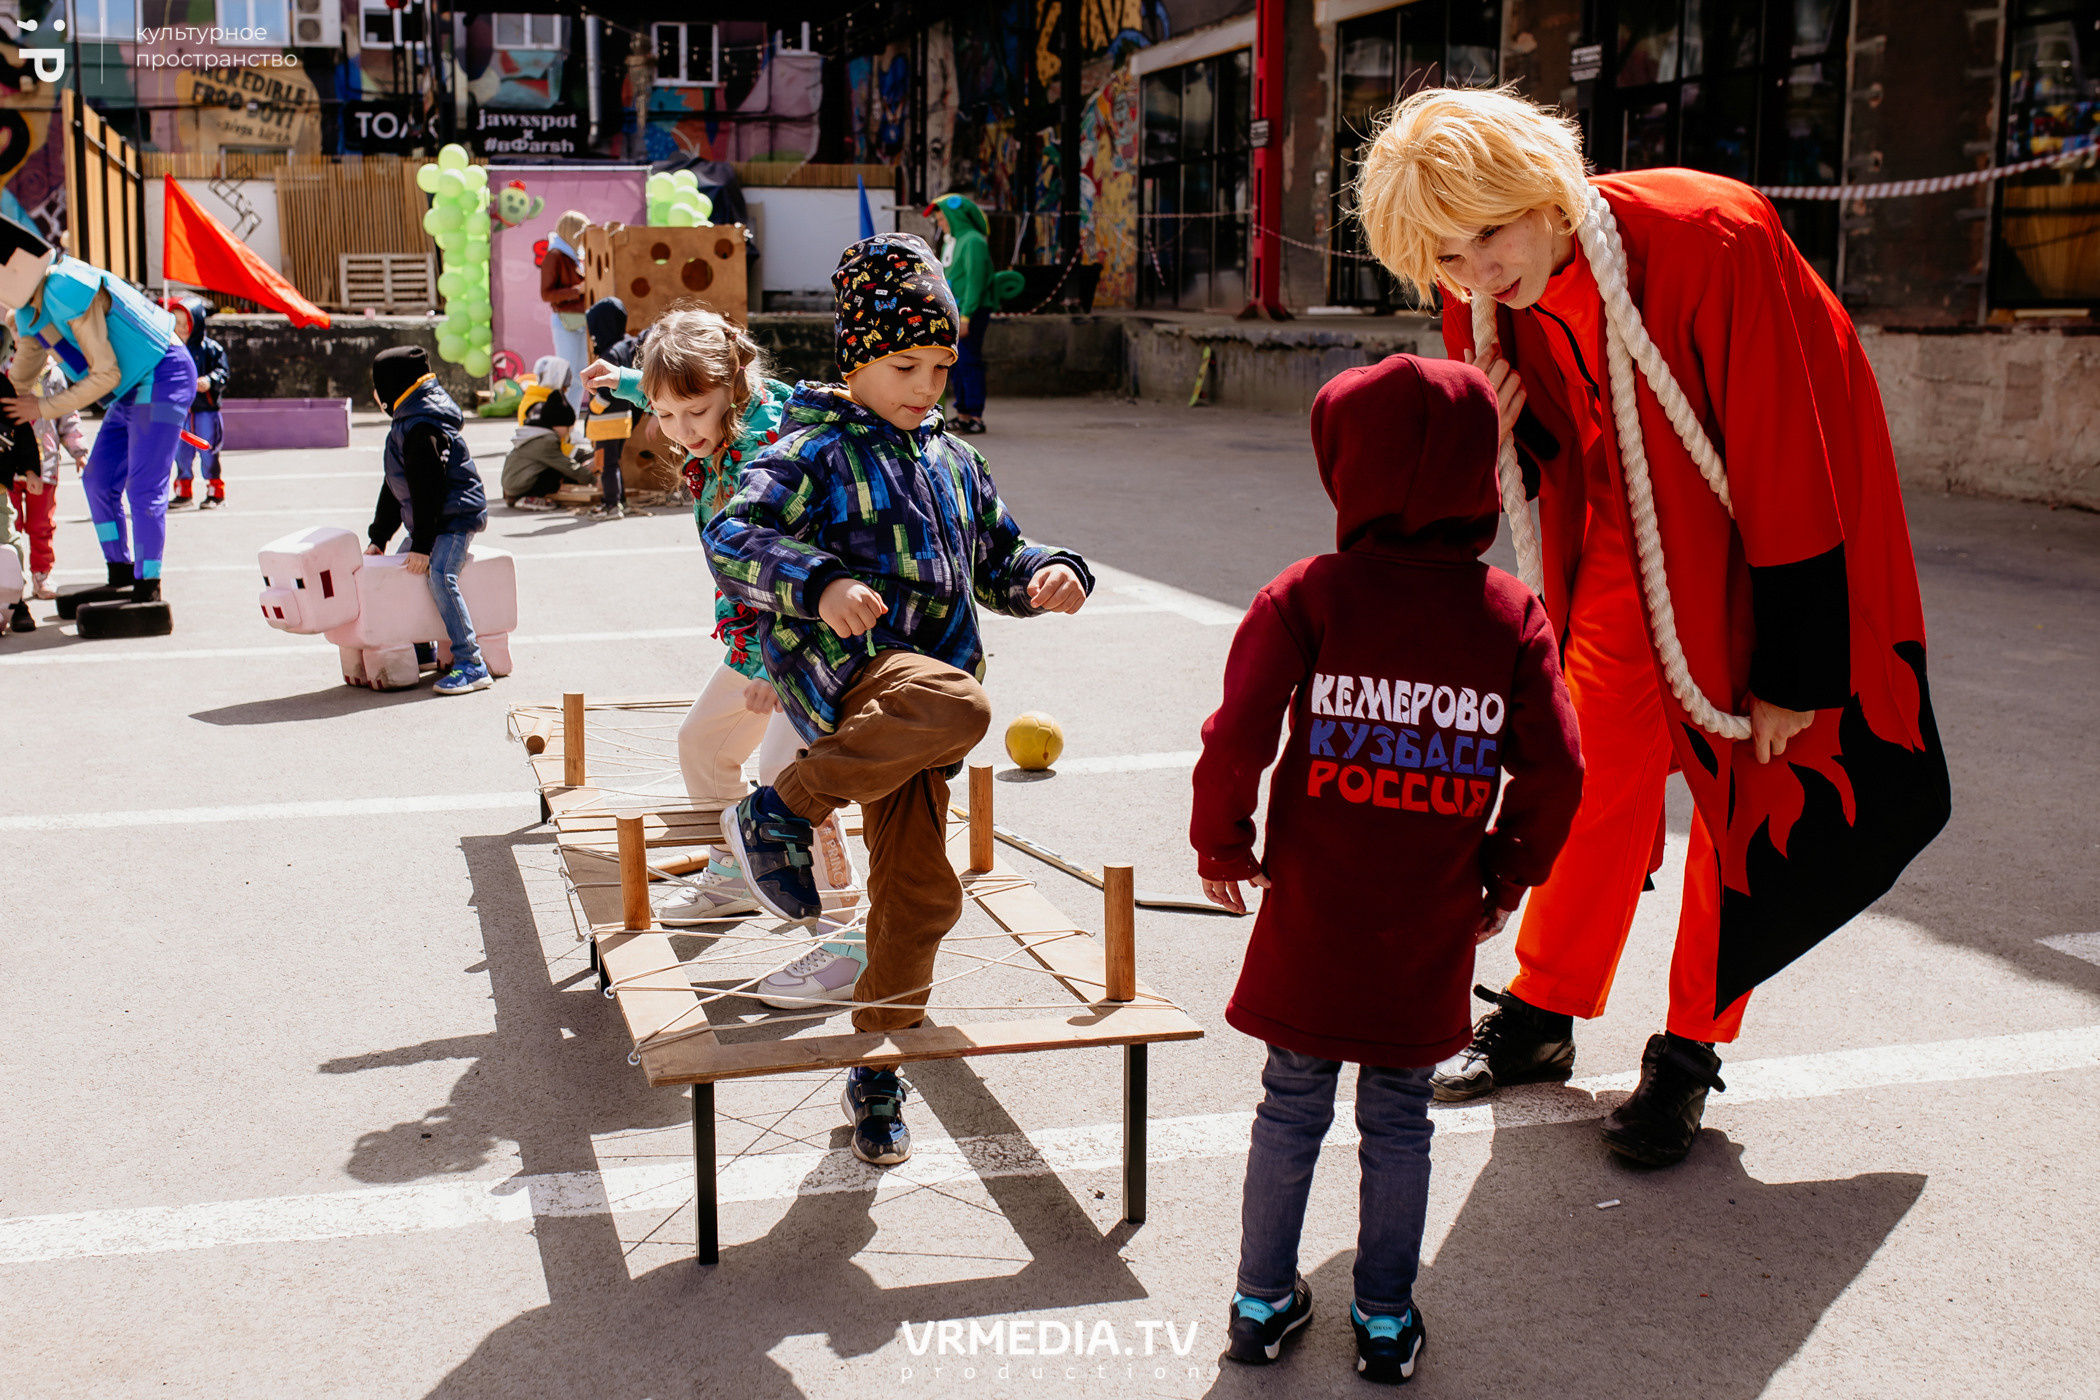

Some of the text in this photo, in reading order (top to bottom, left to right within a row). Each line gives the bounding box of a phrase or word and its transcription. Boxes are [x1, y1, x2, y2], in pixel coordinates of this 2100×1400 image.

[476, 108, 578, 131] jawsspot
[1311, 673, 1505, 734] КЕМЕРОВО
[1309, 719, 1498, 776] КУЗБАСС
[1307, 760, 1491, 817] РОССИЯ
